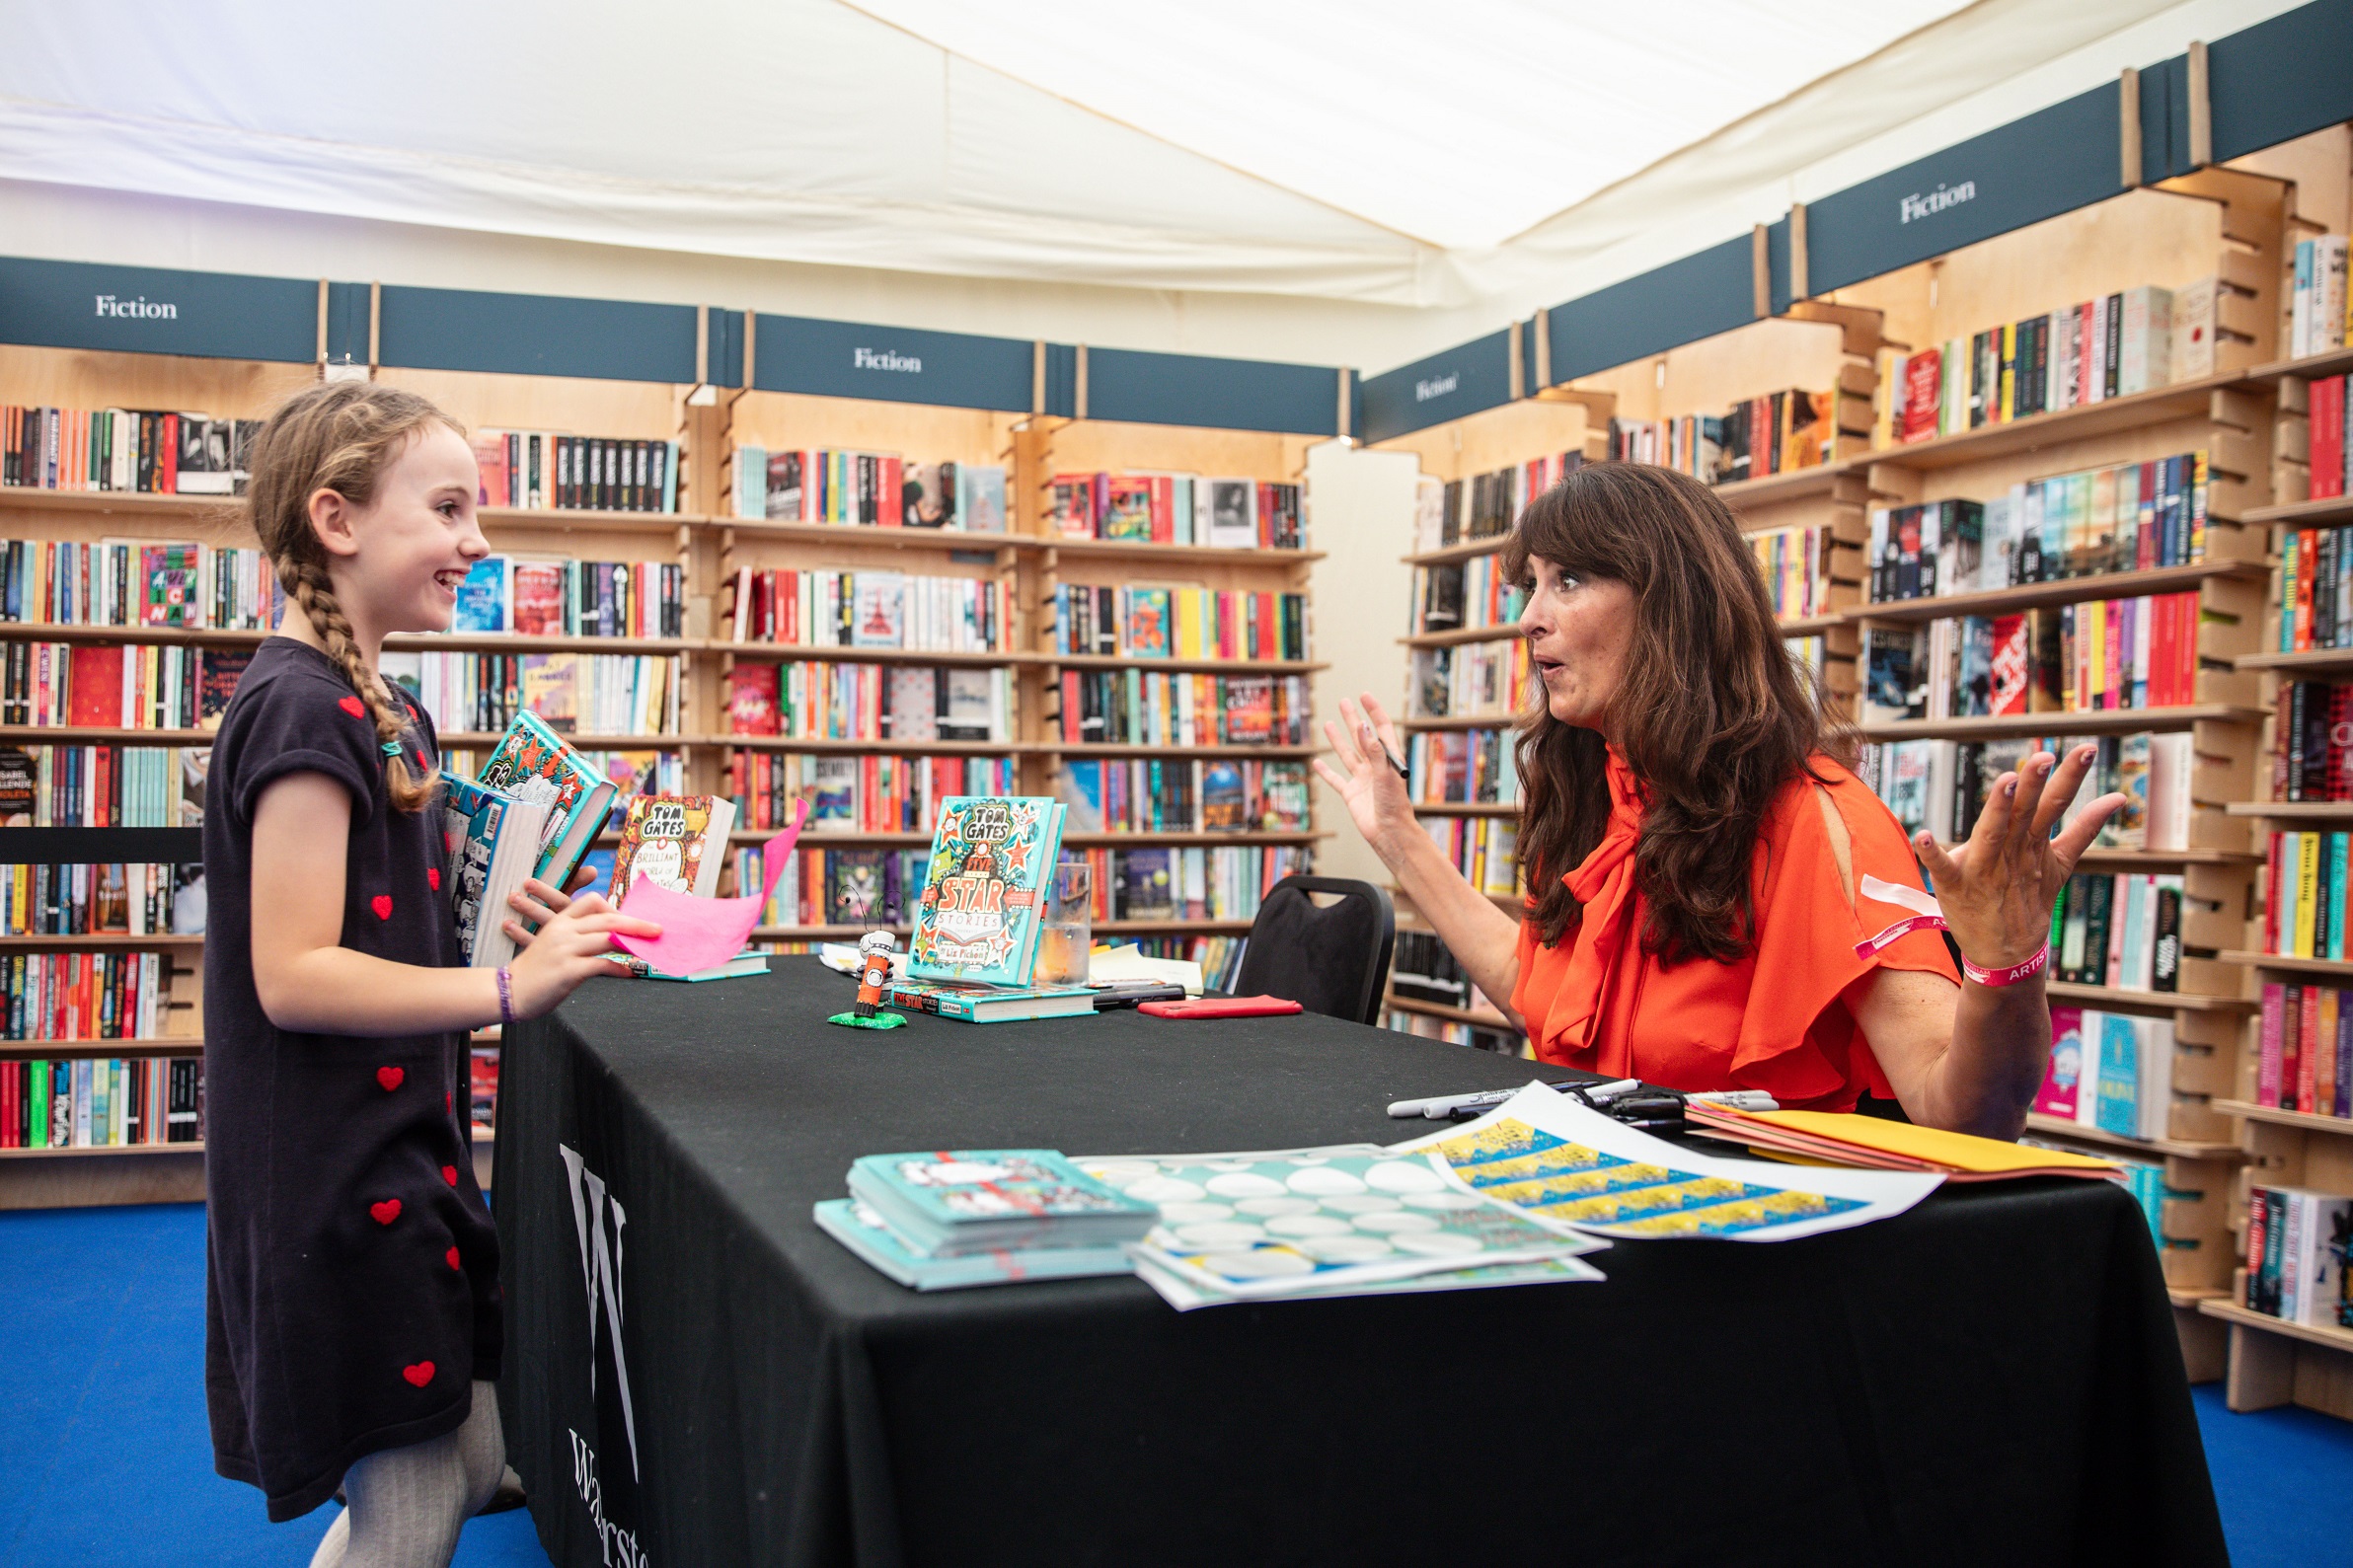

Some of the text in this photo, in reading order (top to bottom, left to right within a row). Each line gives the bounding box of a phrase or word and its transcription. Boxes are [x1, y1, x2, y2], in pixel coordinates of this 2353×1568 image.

[1900, 179, 1977, 224] Fiction
[94, 294, 179, 322] Fiction
[854, 347, 923, 374] Fiction
[1415, 375, 1458, 402] Fiction
[0, 770, 28, 780] SABEL
[0, 780, 33, 789] LENDE
[652, 805, 683, 820] TOM
[974, 807, 1007, 824] TOM
[644, 820, 686, 836] GATES
[966, 823, 1009, 840] GATES
[637, 853, 679, 863] BRILLIANT
[966, 858, 993, 871] FIVE
[938, 877, 1006, 914] STAR
[938, 914, 998, 928] STORIES
[2009, 944, 2049, 981] ARTIST
[905, 995, 923, 1009] STAR
[560, 1143, 639, 1484] W
